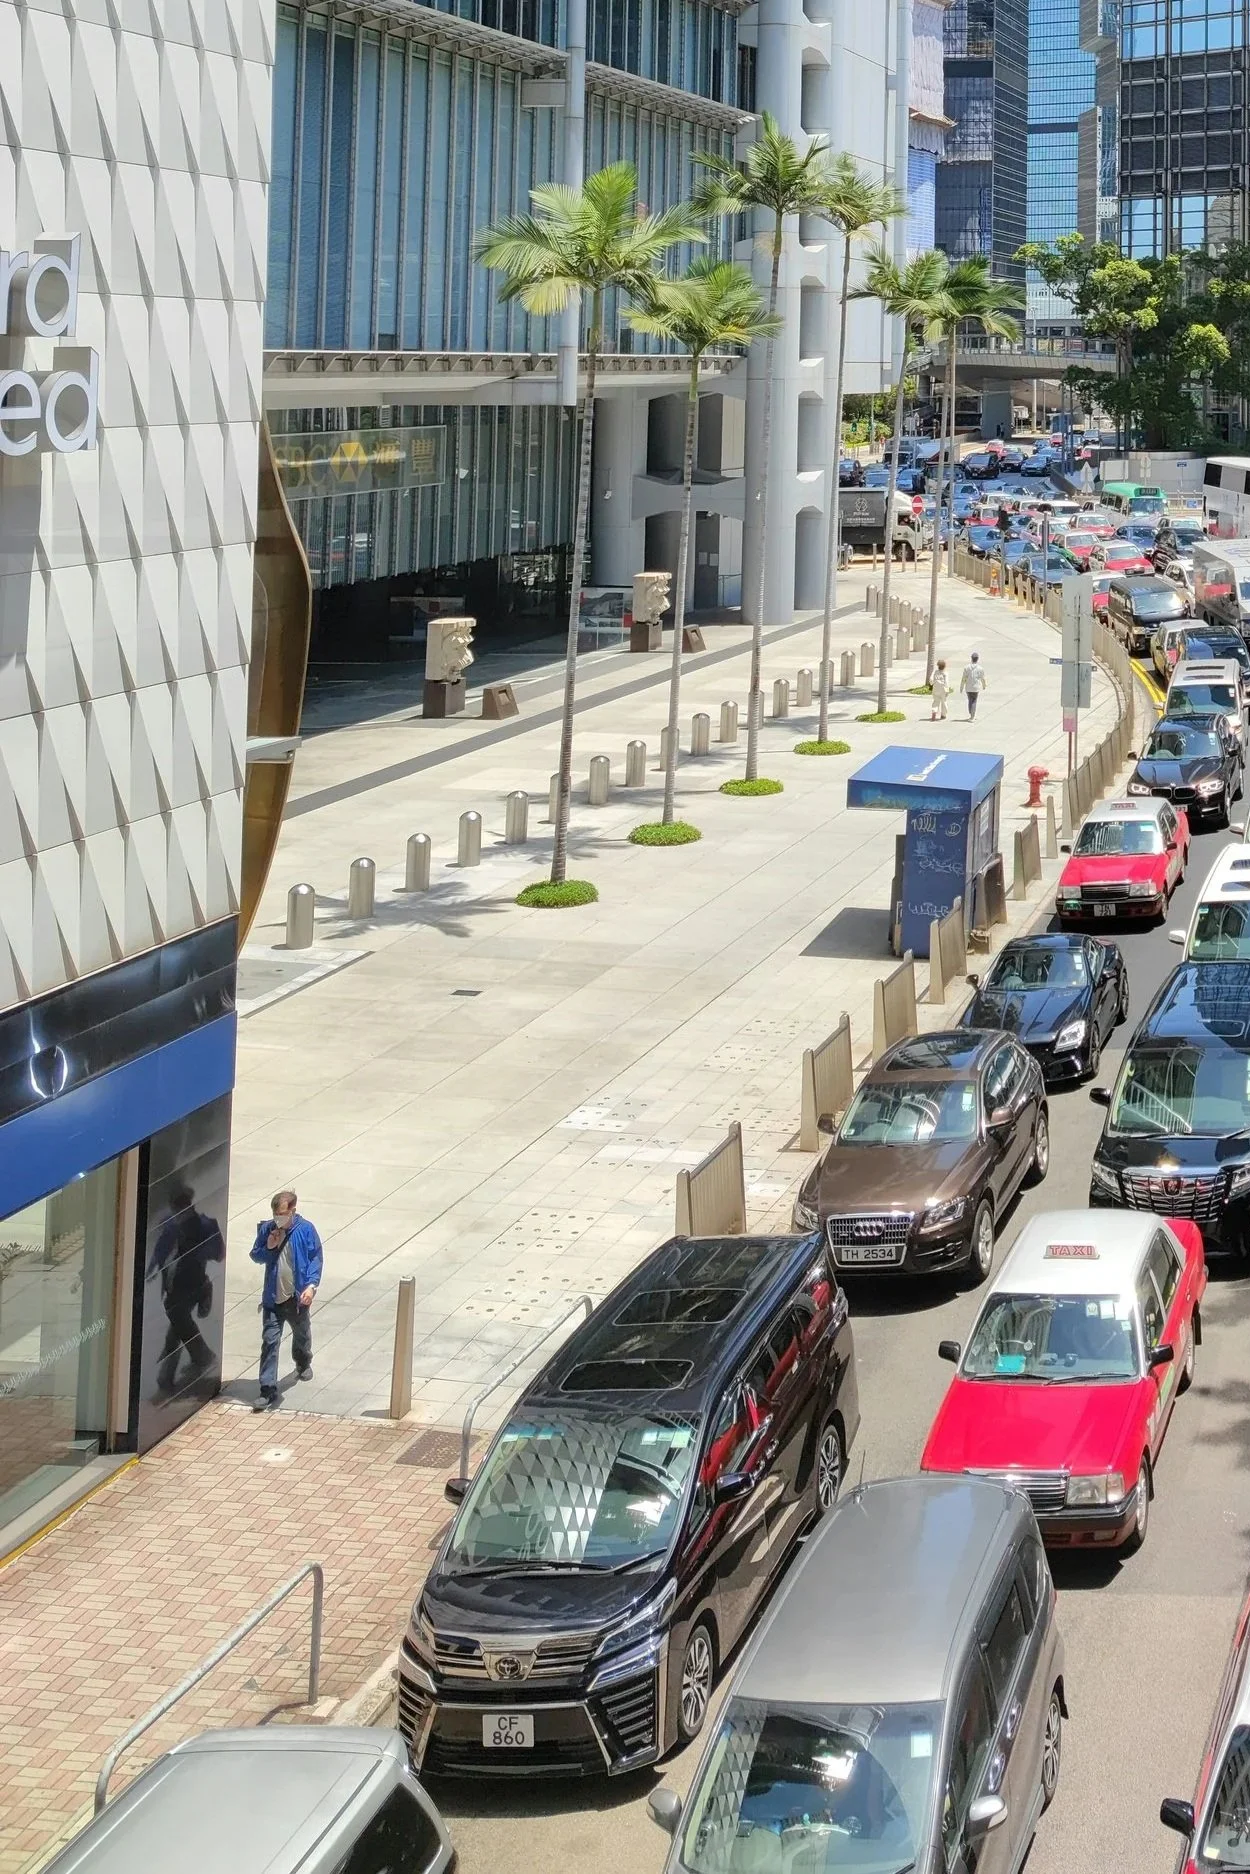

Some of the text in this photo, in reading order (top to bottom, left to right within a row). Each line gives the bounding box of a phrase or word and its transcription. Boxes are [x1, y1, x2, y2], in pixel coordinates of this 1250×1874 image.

[844, 1248, 893, 1259] TH 2534
[1050, 1245, 1093, 1256] TAXI
[497, 1716, 519, 1731] CF
[492, 1731, 525, 1745] 860
